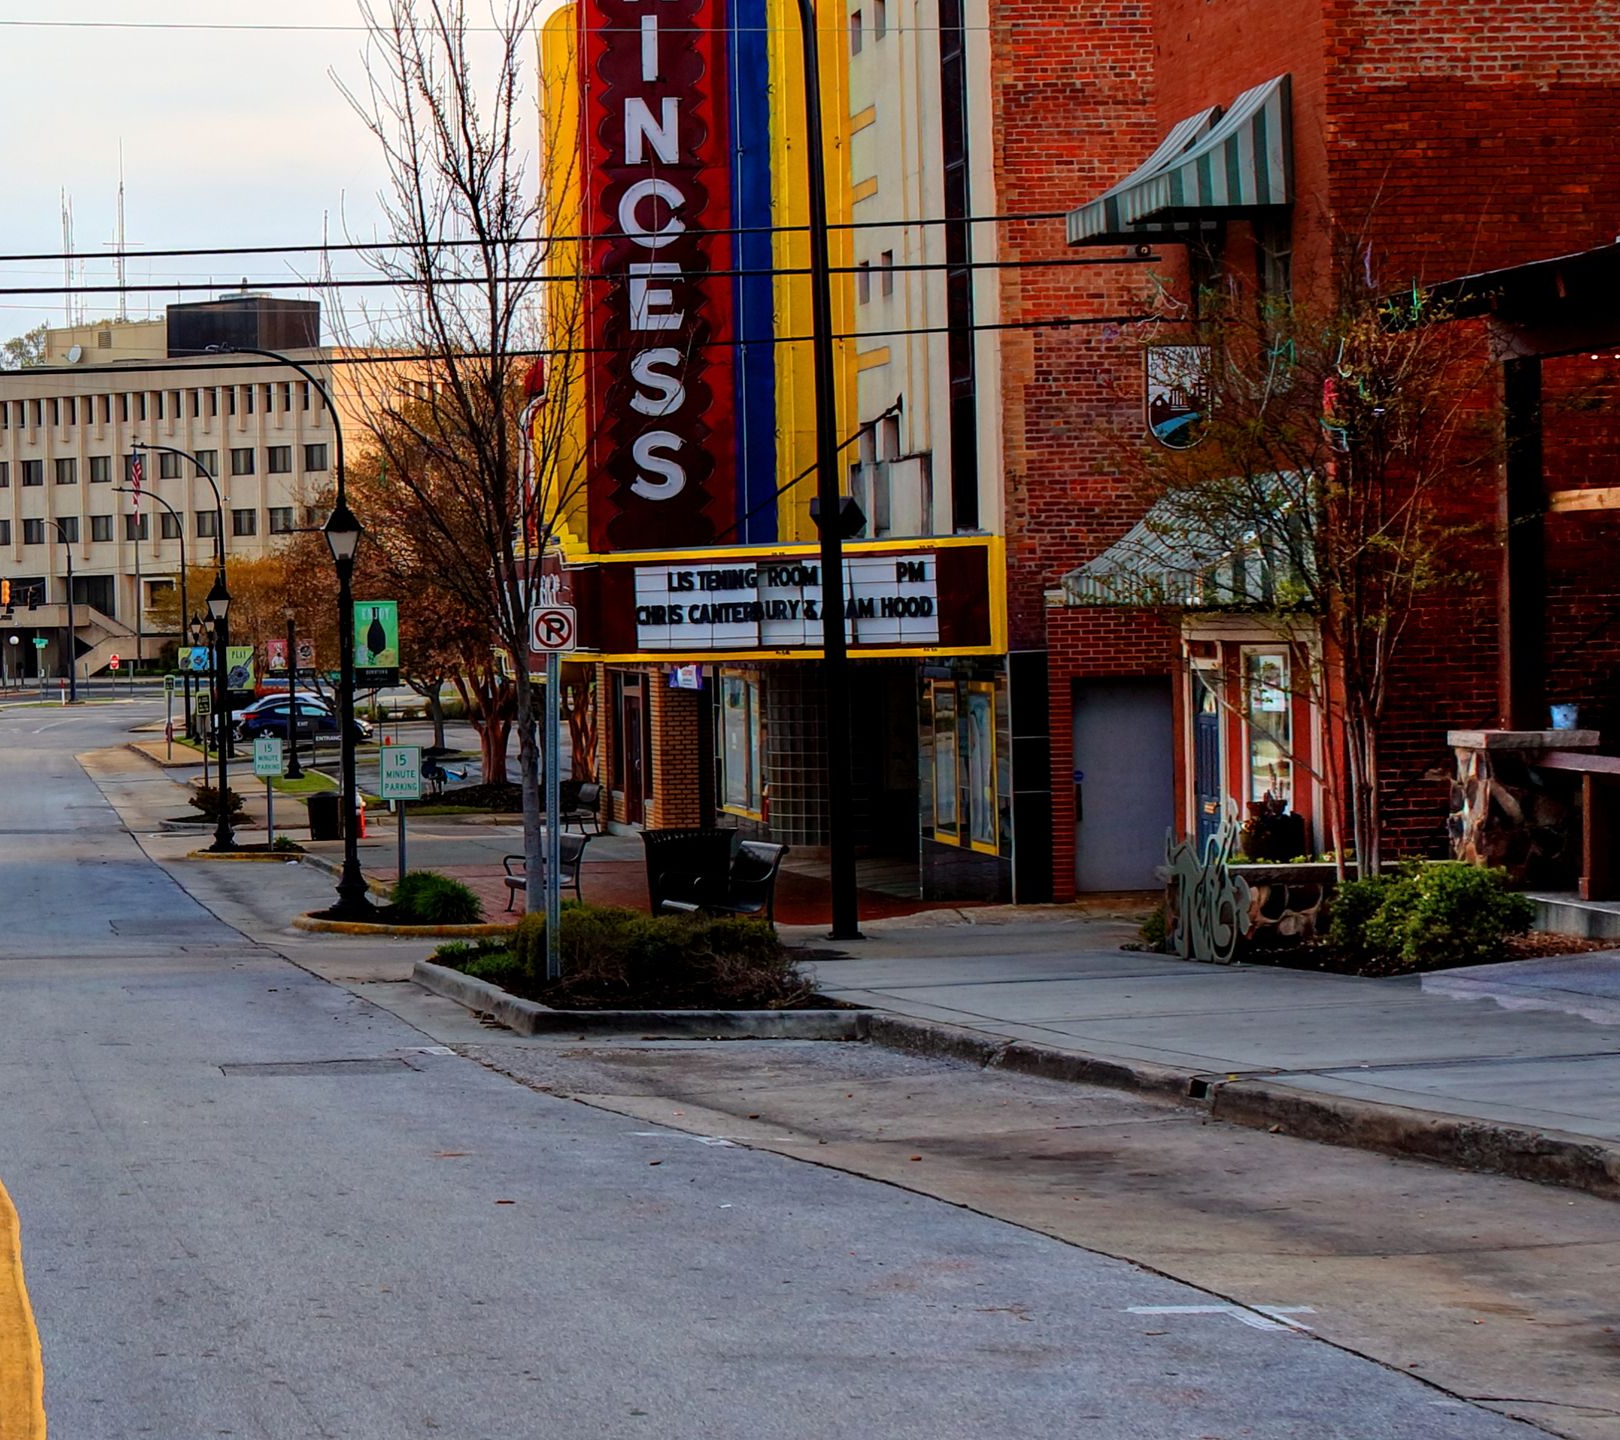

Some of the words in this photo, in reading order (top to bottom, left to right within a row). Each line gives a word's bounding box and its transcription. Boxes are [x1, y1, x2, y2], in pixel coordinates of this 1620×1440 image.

[767, 564, 819, 587] ROOM
[896, 561, 926, 583] PM
[636, 603, 683, 626] CHRIS
[687, 599, 801, 625] CANTERBURY
[880, 595, 932, 618] HOOD
[264, 743, 273, 753] 15
[394, 753, 407, 766] 15
[386, 770, 416, 779] MINUTE
[384, 782, 418, 791] PARKING
